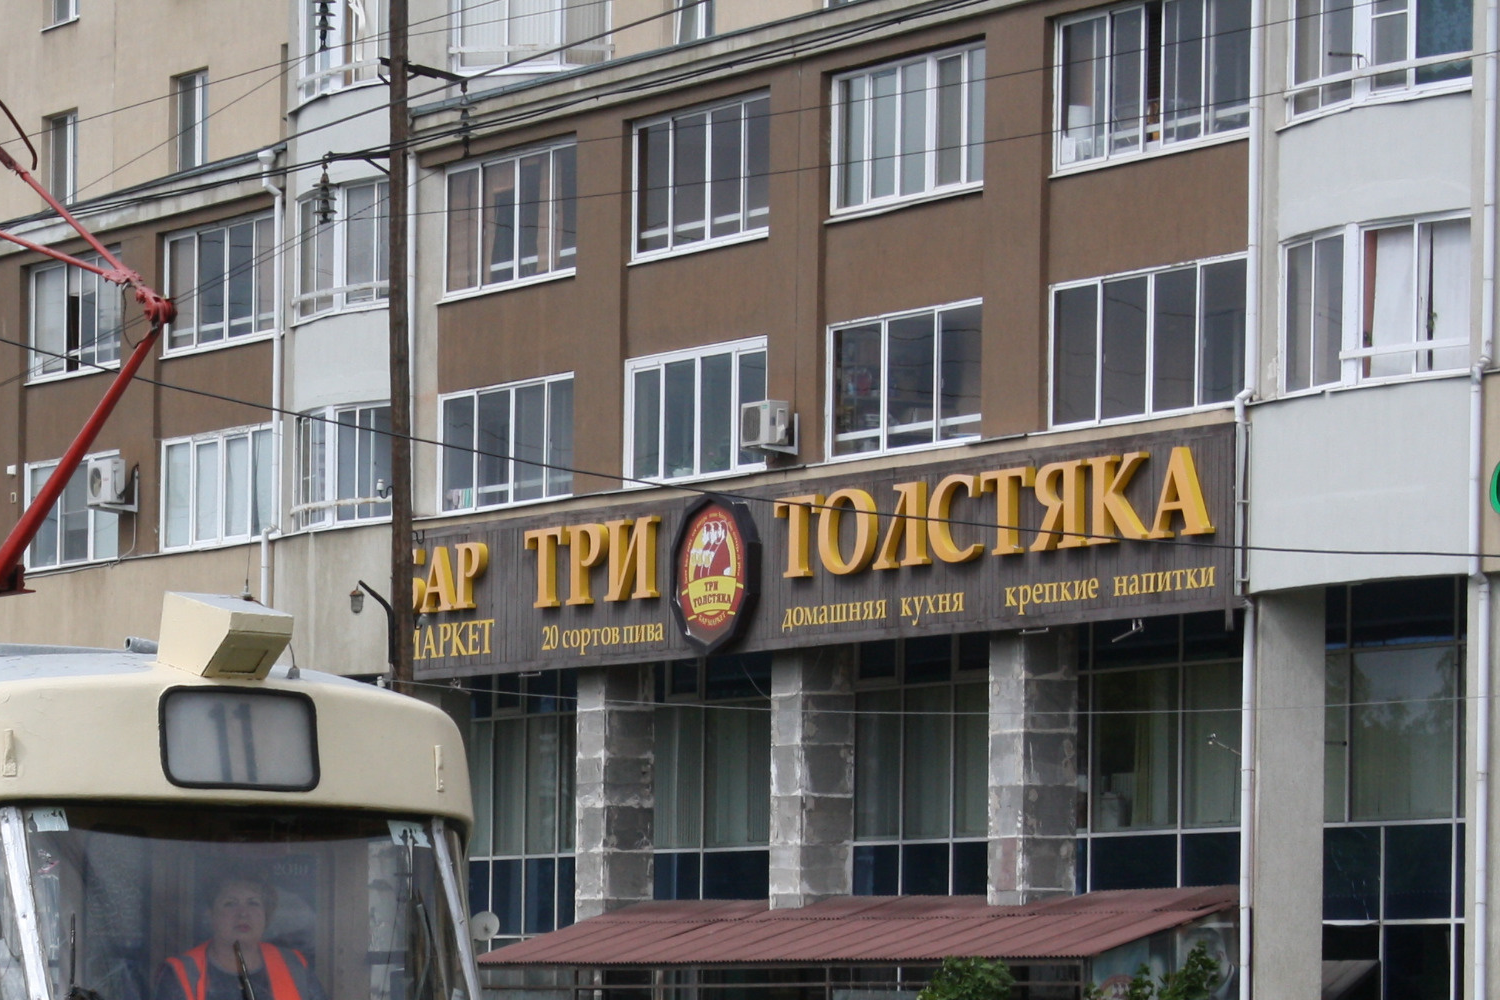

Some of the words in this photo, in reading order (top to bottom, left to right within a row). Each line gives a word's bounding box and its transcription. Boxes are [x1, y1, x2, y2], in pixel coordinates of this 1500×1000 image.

[524, 515, 661, 609] ТРИ
[773, 446, 1216, 579] ТОЛСТЯКА
[693, 593, 732, 608] ТОЛСТЯКА
[704, 581, 719, 592] ТРИ
[1004, 577, 1099, 616] крепкие
[1112, 566, 1216, 597] напитки
[781, 600, 887, 633] домашняя
[900, 591, 965, 626] кухня
[541, 625, 559, 651] 20
[562, 626, 620, 656] сортов
[622, 622, 664, 645] пива
[208, 702, 259, 784] 11
